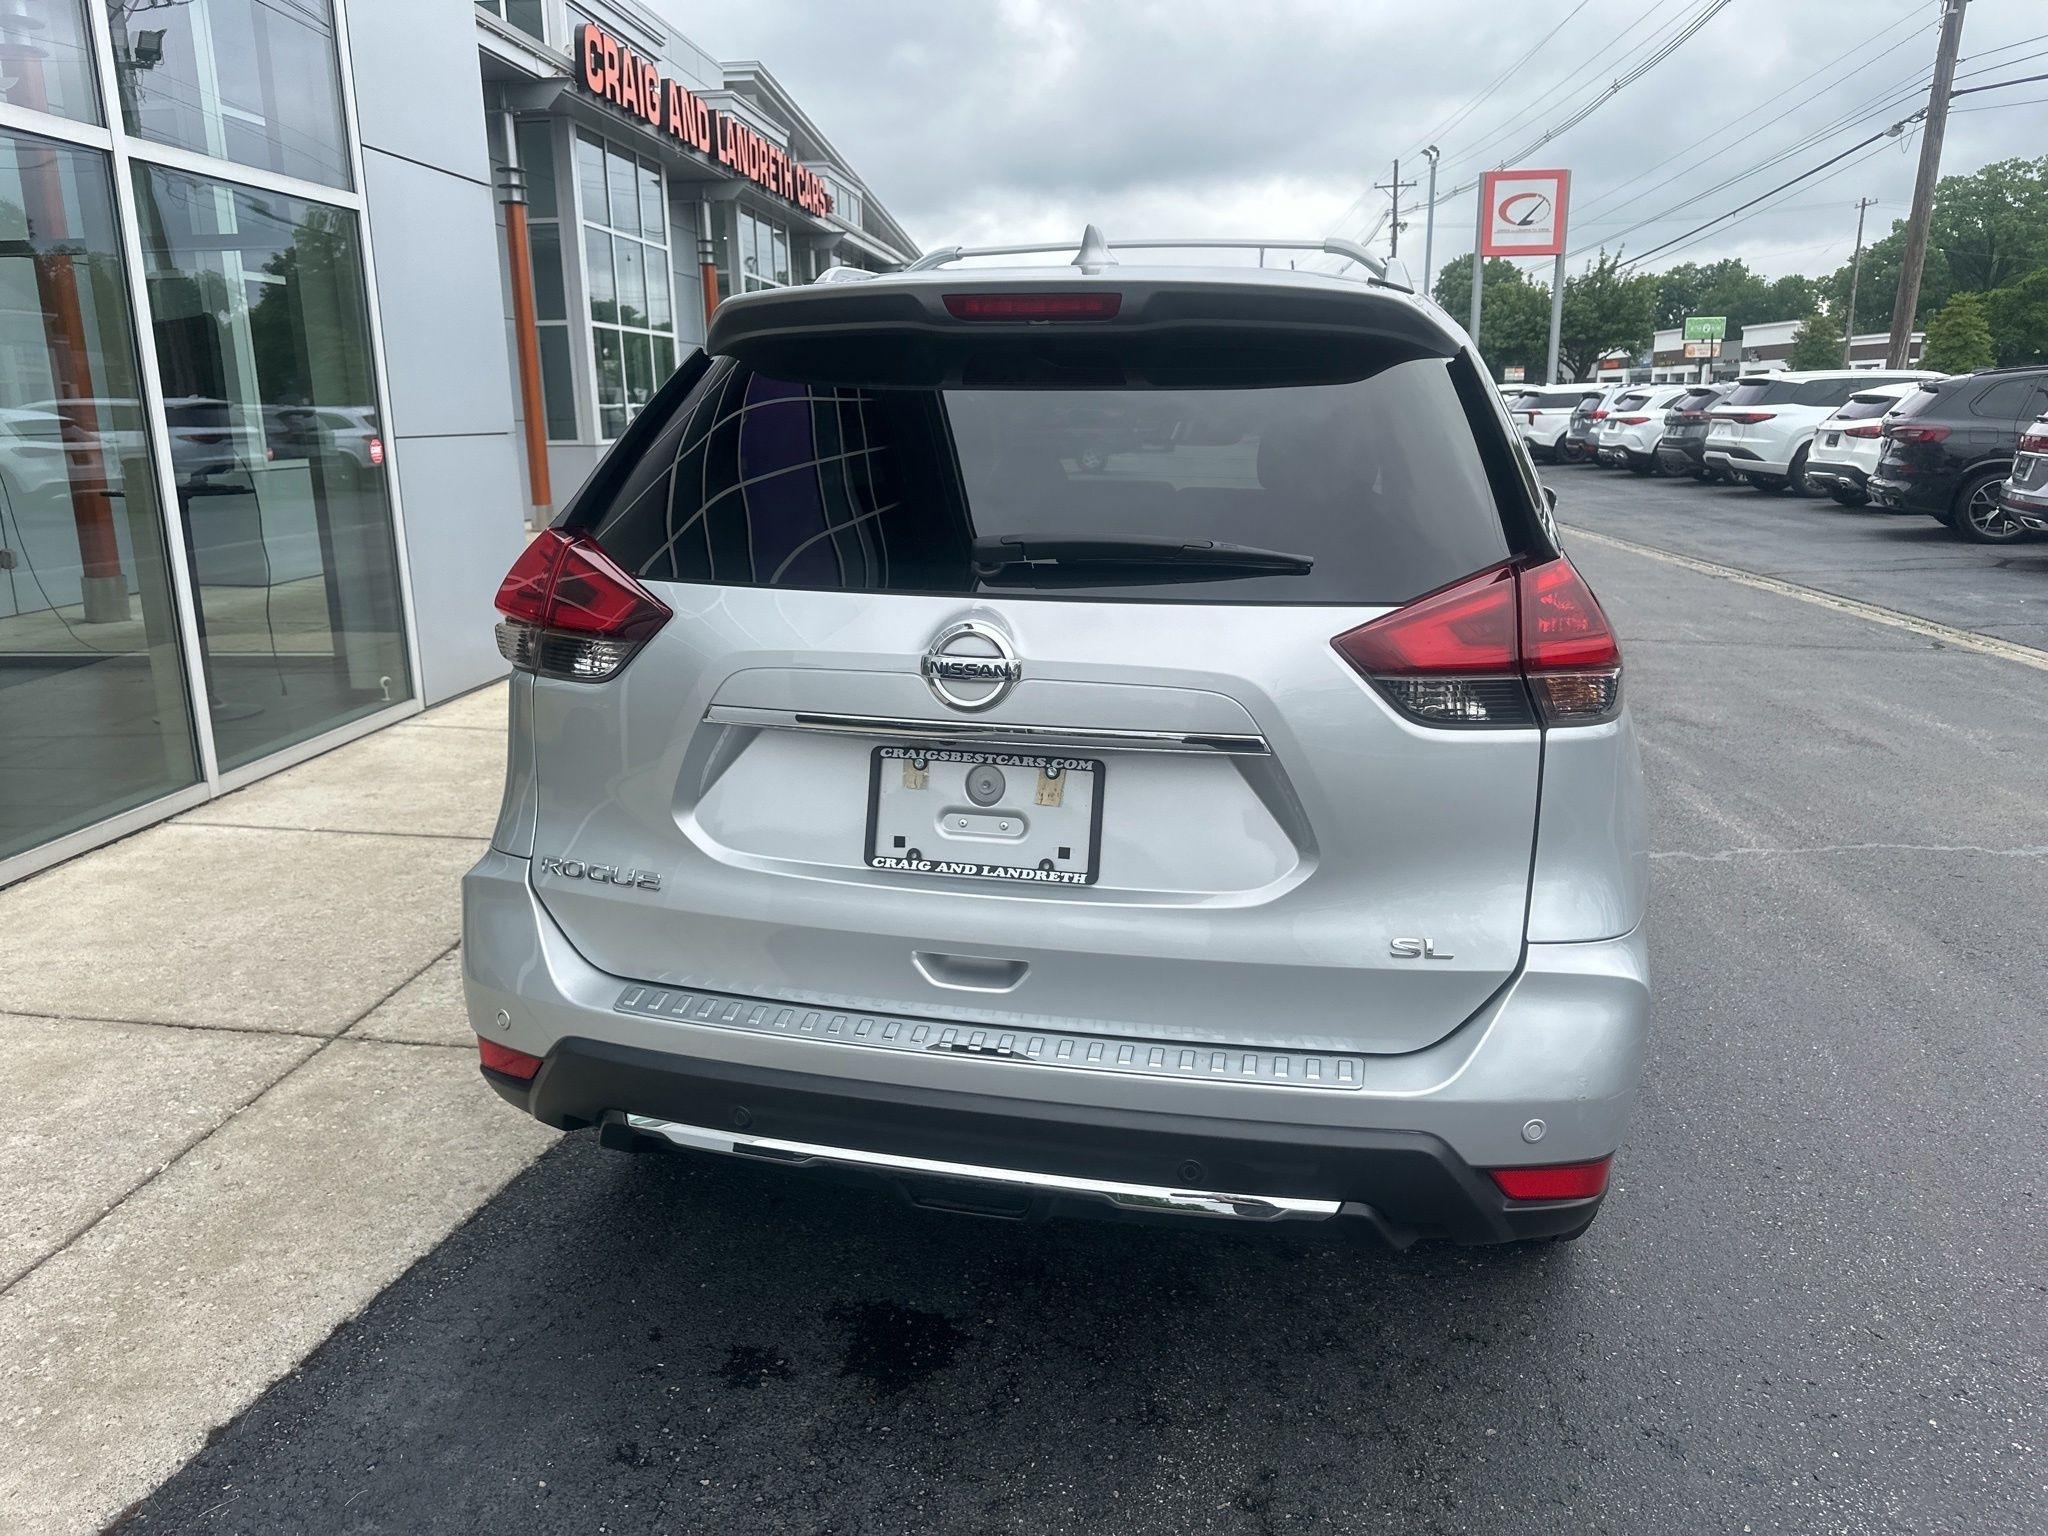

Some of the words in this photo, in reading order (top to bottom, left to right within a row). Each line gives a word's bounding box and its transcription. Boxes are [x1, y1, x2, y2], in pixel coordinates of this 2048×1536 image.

[580, 23, 662, 127] CRAIG
[667, 78, 711, 154] AND
[715, 109, 794, 201] LANDRETH
[796, 162, 827, 219] CARS
[929, 660, 1012, 680] NISSAN
[880, 748, 1094, 771] CRAIGSBESTCARS.COM
[541, 856, 662, 892] ROGUE
[872, 857, 931, 871] CRAIG
[936, 862, 977, 875] AND
[981, 865, 1088, 884] LANDRETH
[1390, 937, 1455, 960] SL
